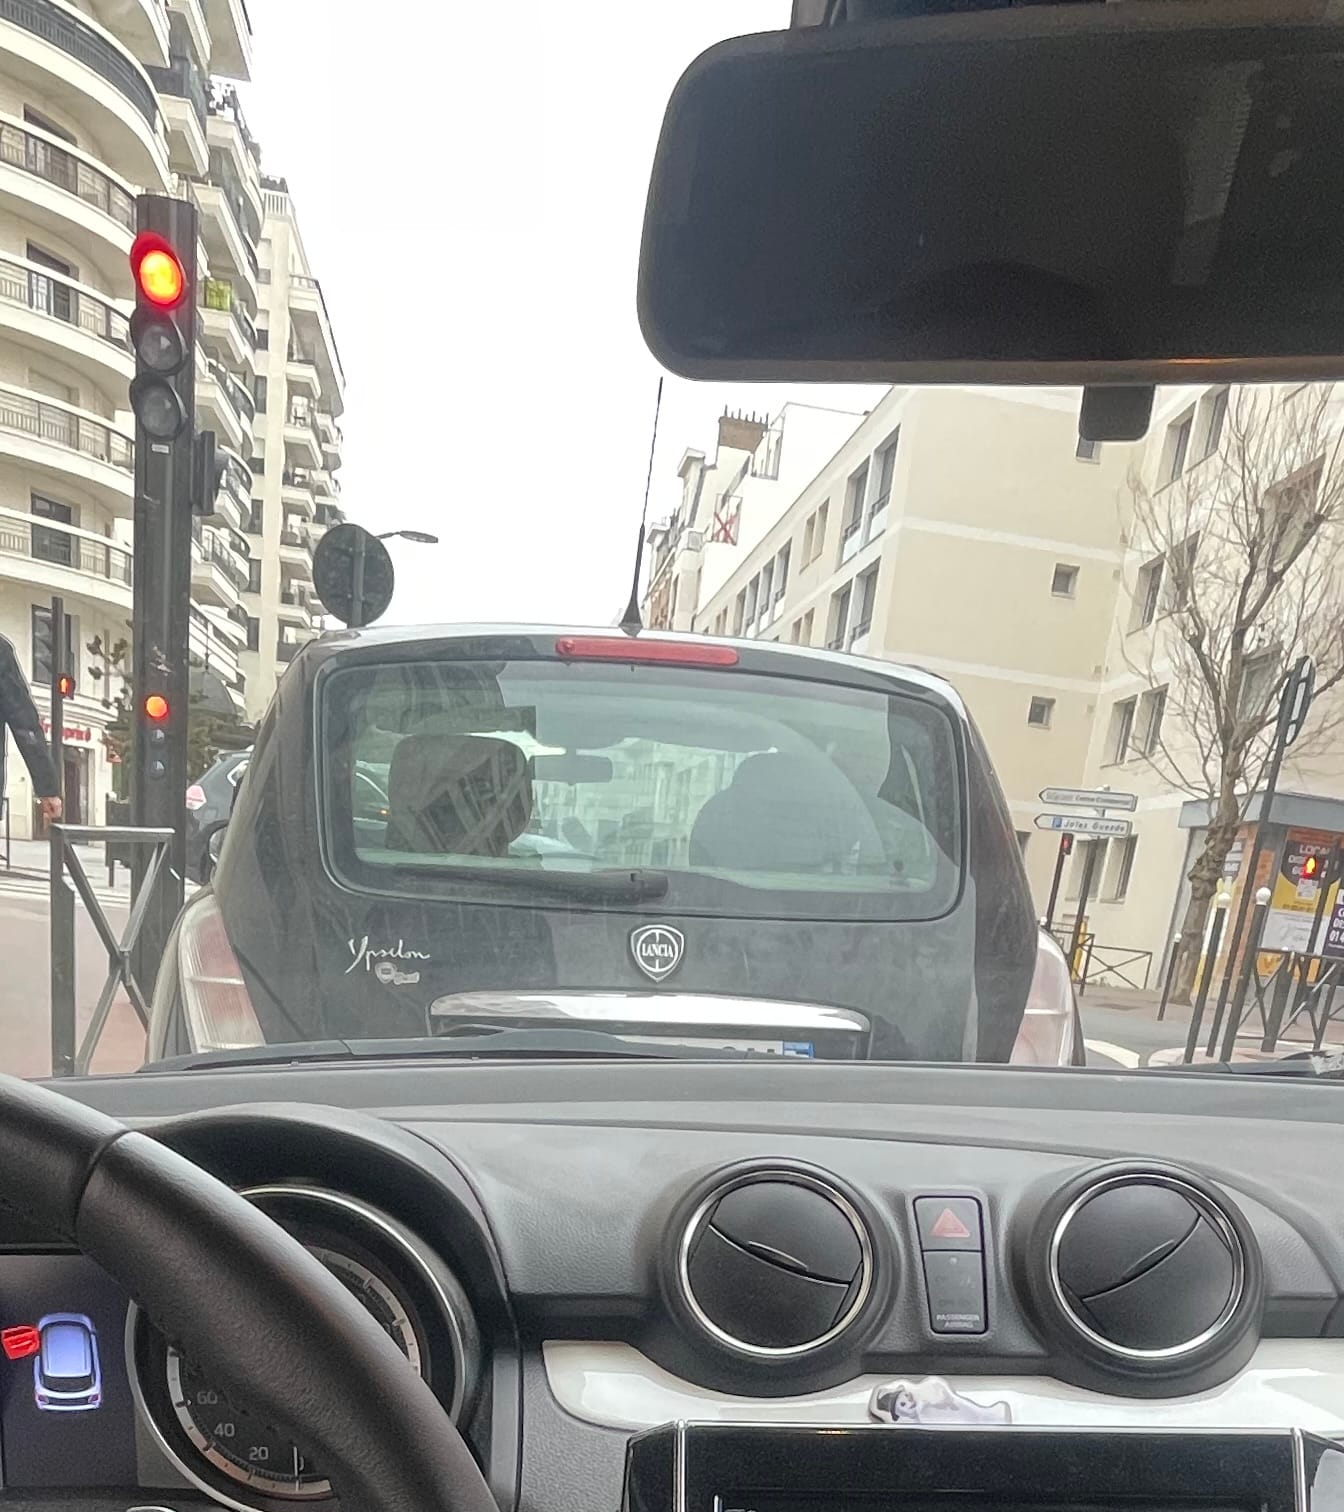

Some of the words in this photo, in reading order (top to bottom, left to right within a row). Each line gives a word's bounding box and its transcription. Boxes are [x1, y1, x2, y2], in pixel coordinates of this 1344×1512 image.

[344, 935, 431, 975] Ypsilon
[641, 942, 674, 958] LANCIA
[196, 1390, 219, 1405] 60
[213, 1422, 236, 1438] 40
[248, 1446, 270, 1461] 20
